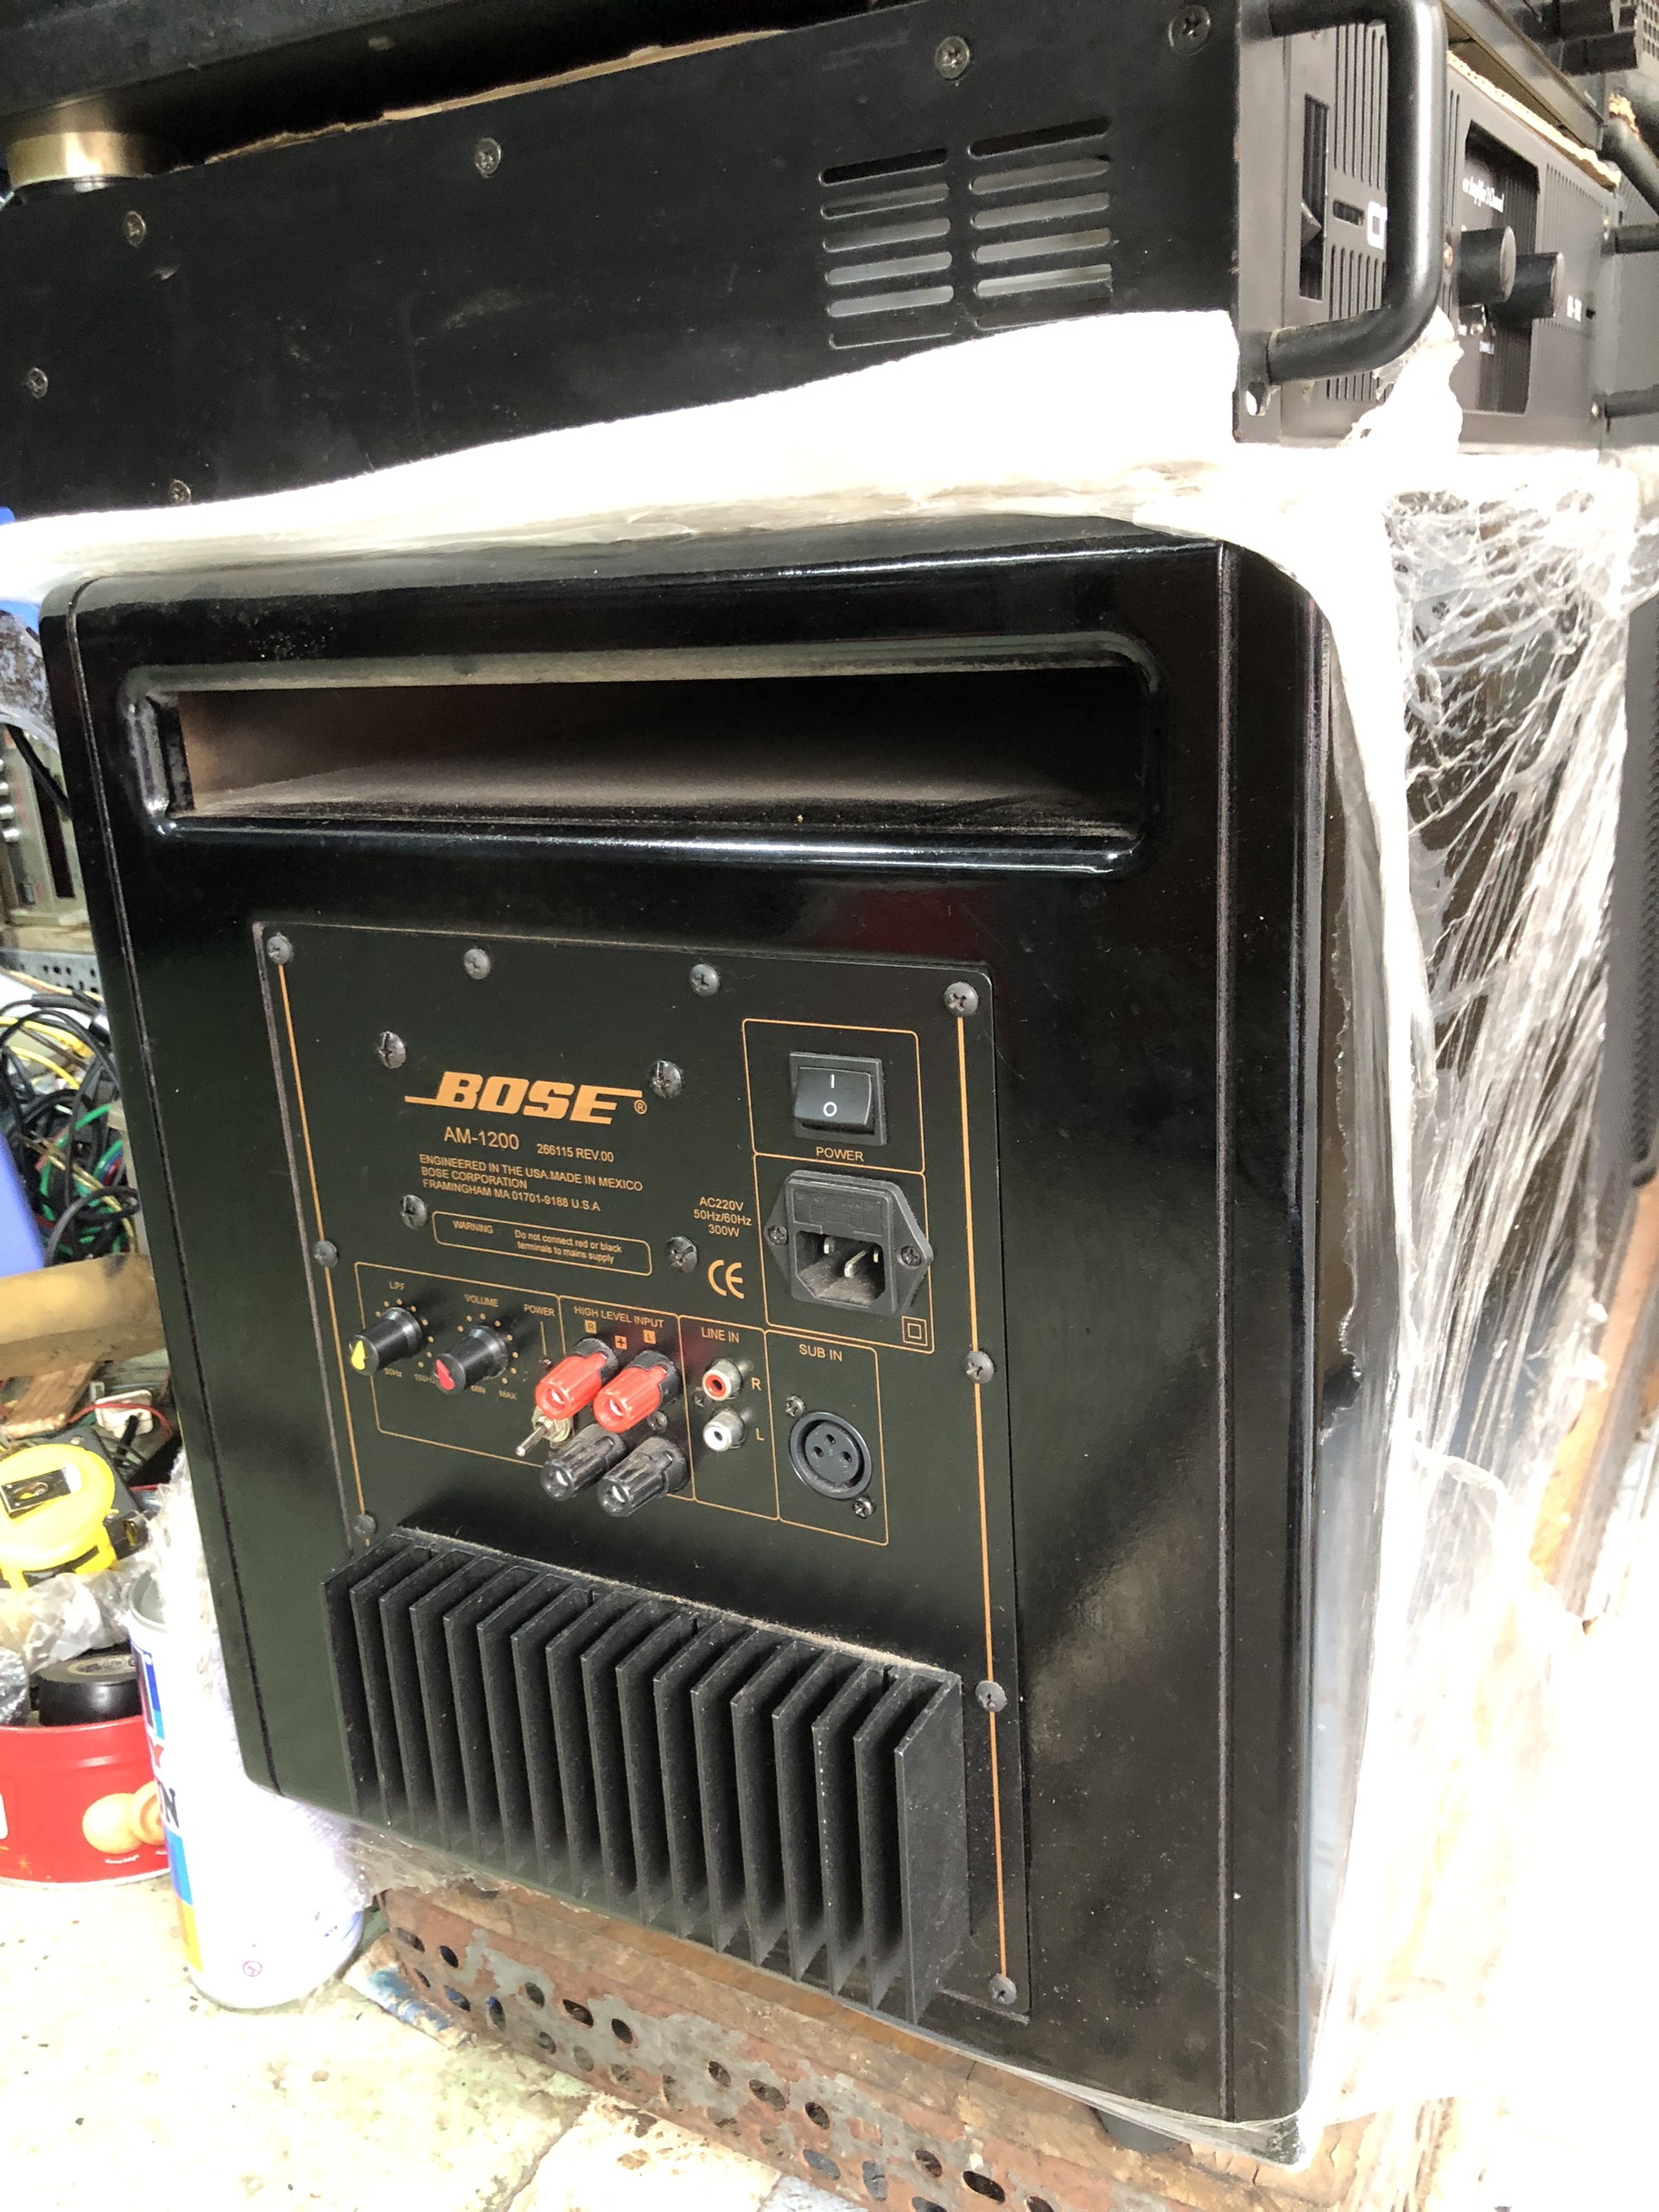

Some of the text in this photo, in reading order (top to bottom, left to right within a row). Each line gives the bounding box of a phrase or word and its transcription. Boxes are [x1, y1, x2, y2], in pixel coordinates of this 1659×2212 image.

[404, 1071, 643, 1124] BOSE
[444, 1127, 520, 1150] AM-1200
[537, 1143, 614, 1162] 266115 REV.00
[816, 1146, 864, 1162] POWER
[419, 1154, 487, 1172] ENGINEERED
[489, 1162, 499, 1173] IN
[501, 1164, 524, 1177] THE
[584, 1174, 596, 1185] IN
[599, 1177, 644, 1192] MEXICO
[421, 1166, 528, 1190] BOSE CORPORATION
[423, 1179, 492, 1198] FRAMINGHAM
[699, 1196, 744, 1211] AC220V
[453, 1219, 493, 1234] WARNING
[693, 1209, 753, 1227] 50Hz/60Hz
[709, 1224, 741, 1237] 300W
[514, 1230, 526, 1239] Do
[528, 1233, 541, 1242] not
[542, 1235, 574, 1246] connect
[575, 1239, 588, 1249] red
[601, 1243, 622, 1253] black
[517, 1241, 614, 1264] terminals to mains supply
[464, 1294, 499, 1307] VOLUME
[524, 1304, 555, 1317] POWER
[574, 1306, 664, 1328] HIGH LEVEL INPUT
[701, 1326, 741, 1344] LINE IN
[798, 1344, 842, 1362] SUB IN
[751, 1377, 761, 1391] R
[499, 1389, 517, 1400] MAX
[755, 1428, 766, 1441] L
